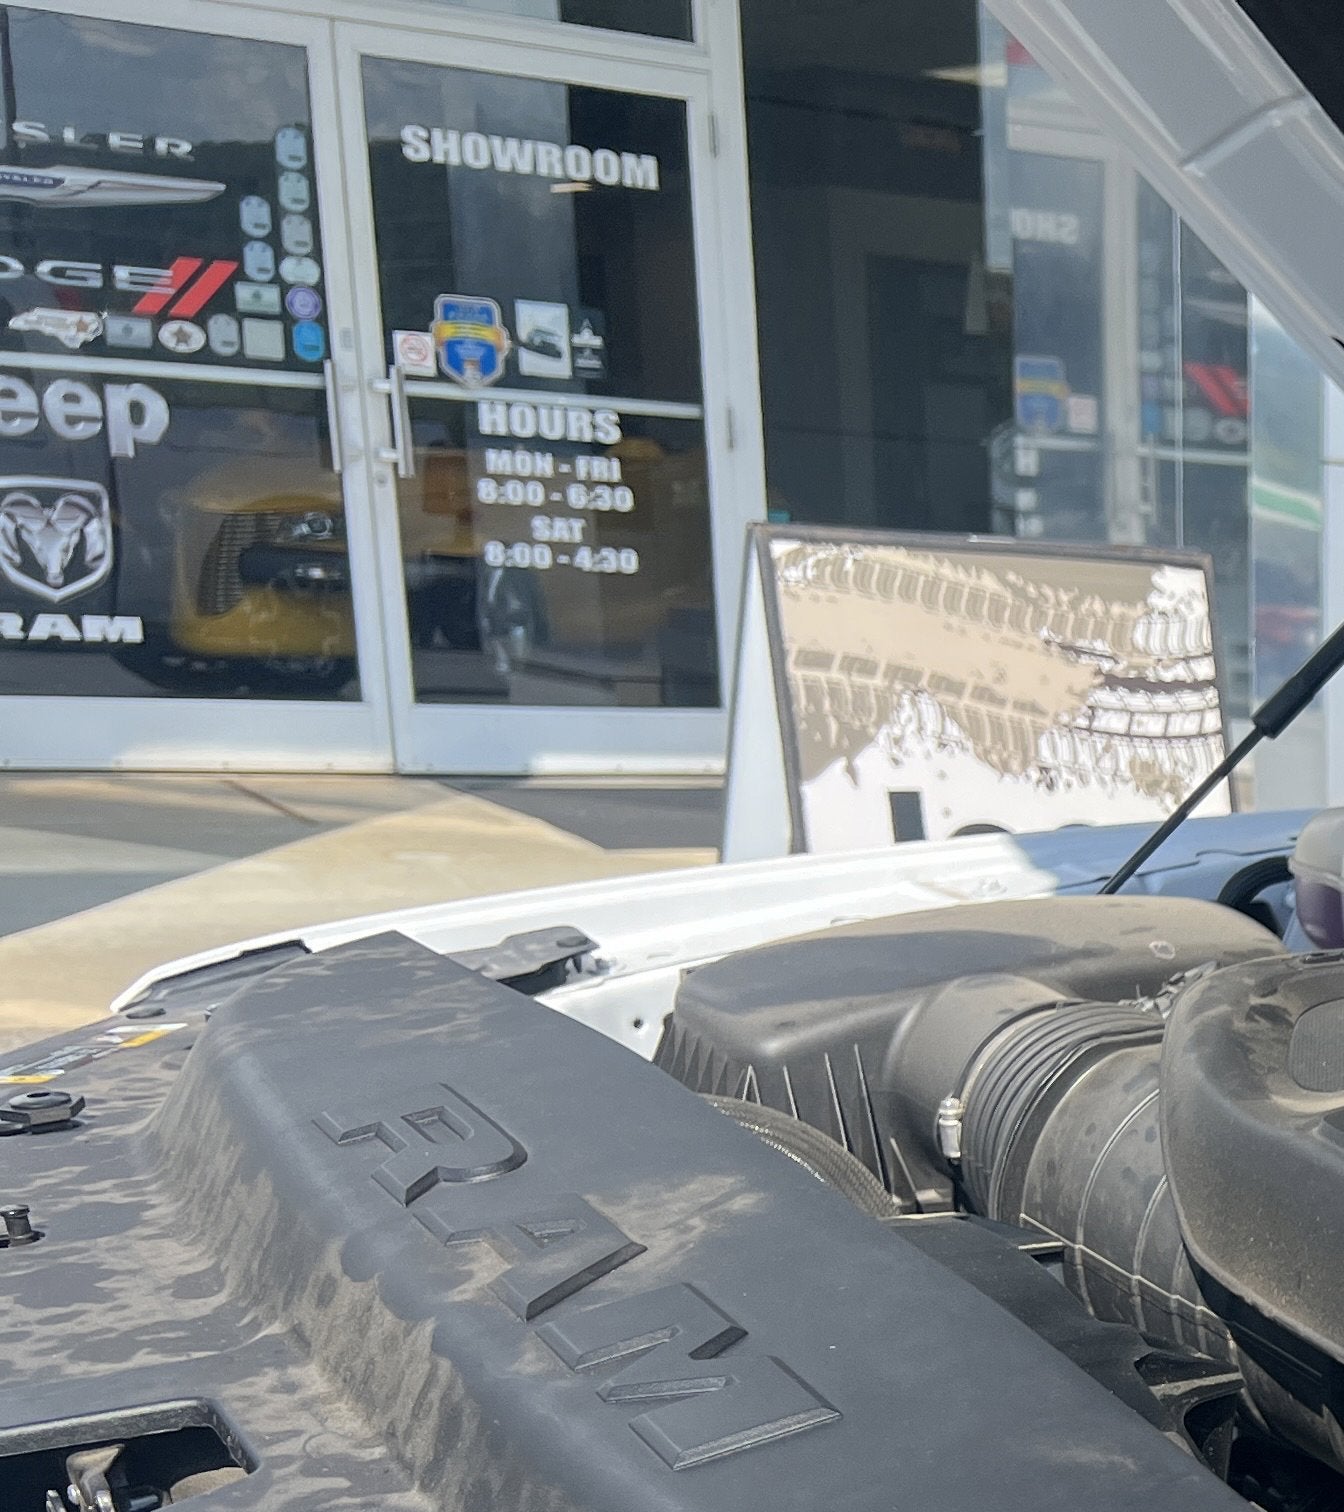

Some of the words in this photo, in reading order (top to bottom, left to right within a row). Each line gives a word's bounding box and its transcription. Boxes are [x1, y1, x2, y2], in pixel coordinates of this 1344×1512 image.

[400, 124, 660, 191] SHOWROOM
[477, 400, 623, 445] HOURS
[485, 448, 555, 478] MON
[575, 455, 622, 483] FRI
[476, 477, 546, 507] 8:00
[530, 515, 587, 543] SAT
[484, 540, 553, 570] 8:00
[0, 612, 144, 643] RAM
[312, 1083, 843, 1470] RAM
